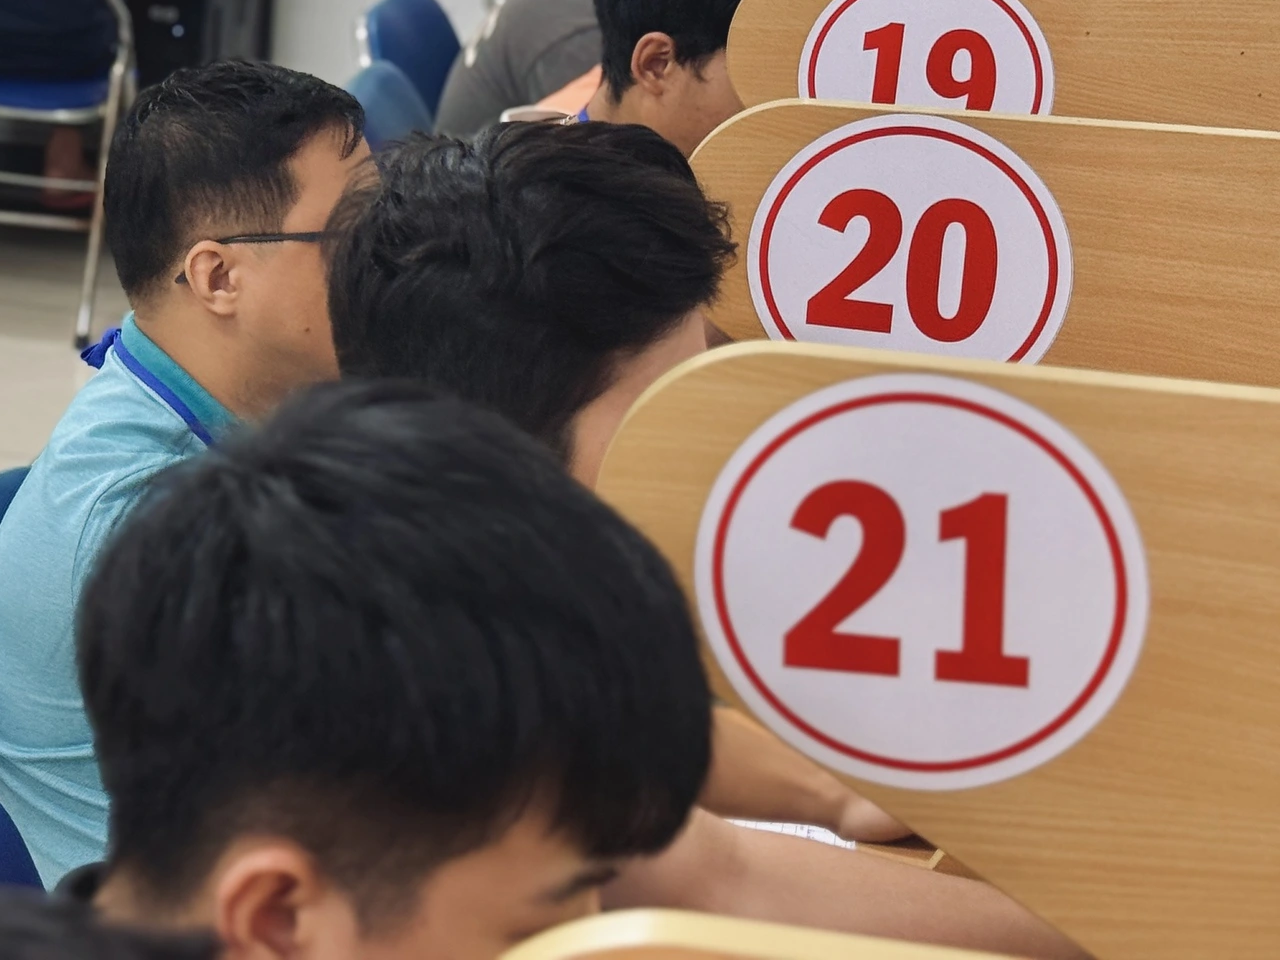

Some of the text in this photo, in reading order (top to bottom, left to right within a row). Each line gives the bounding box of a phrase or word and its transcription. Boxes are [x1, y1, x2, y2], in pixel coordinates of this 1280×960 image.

[863, 22, 997, 112] 19
[805, 188, 998, 343] 20
[783, 479, 1031, 689] 21
